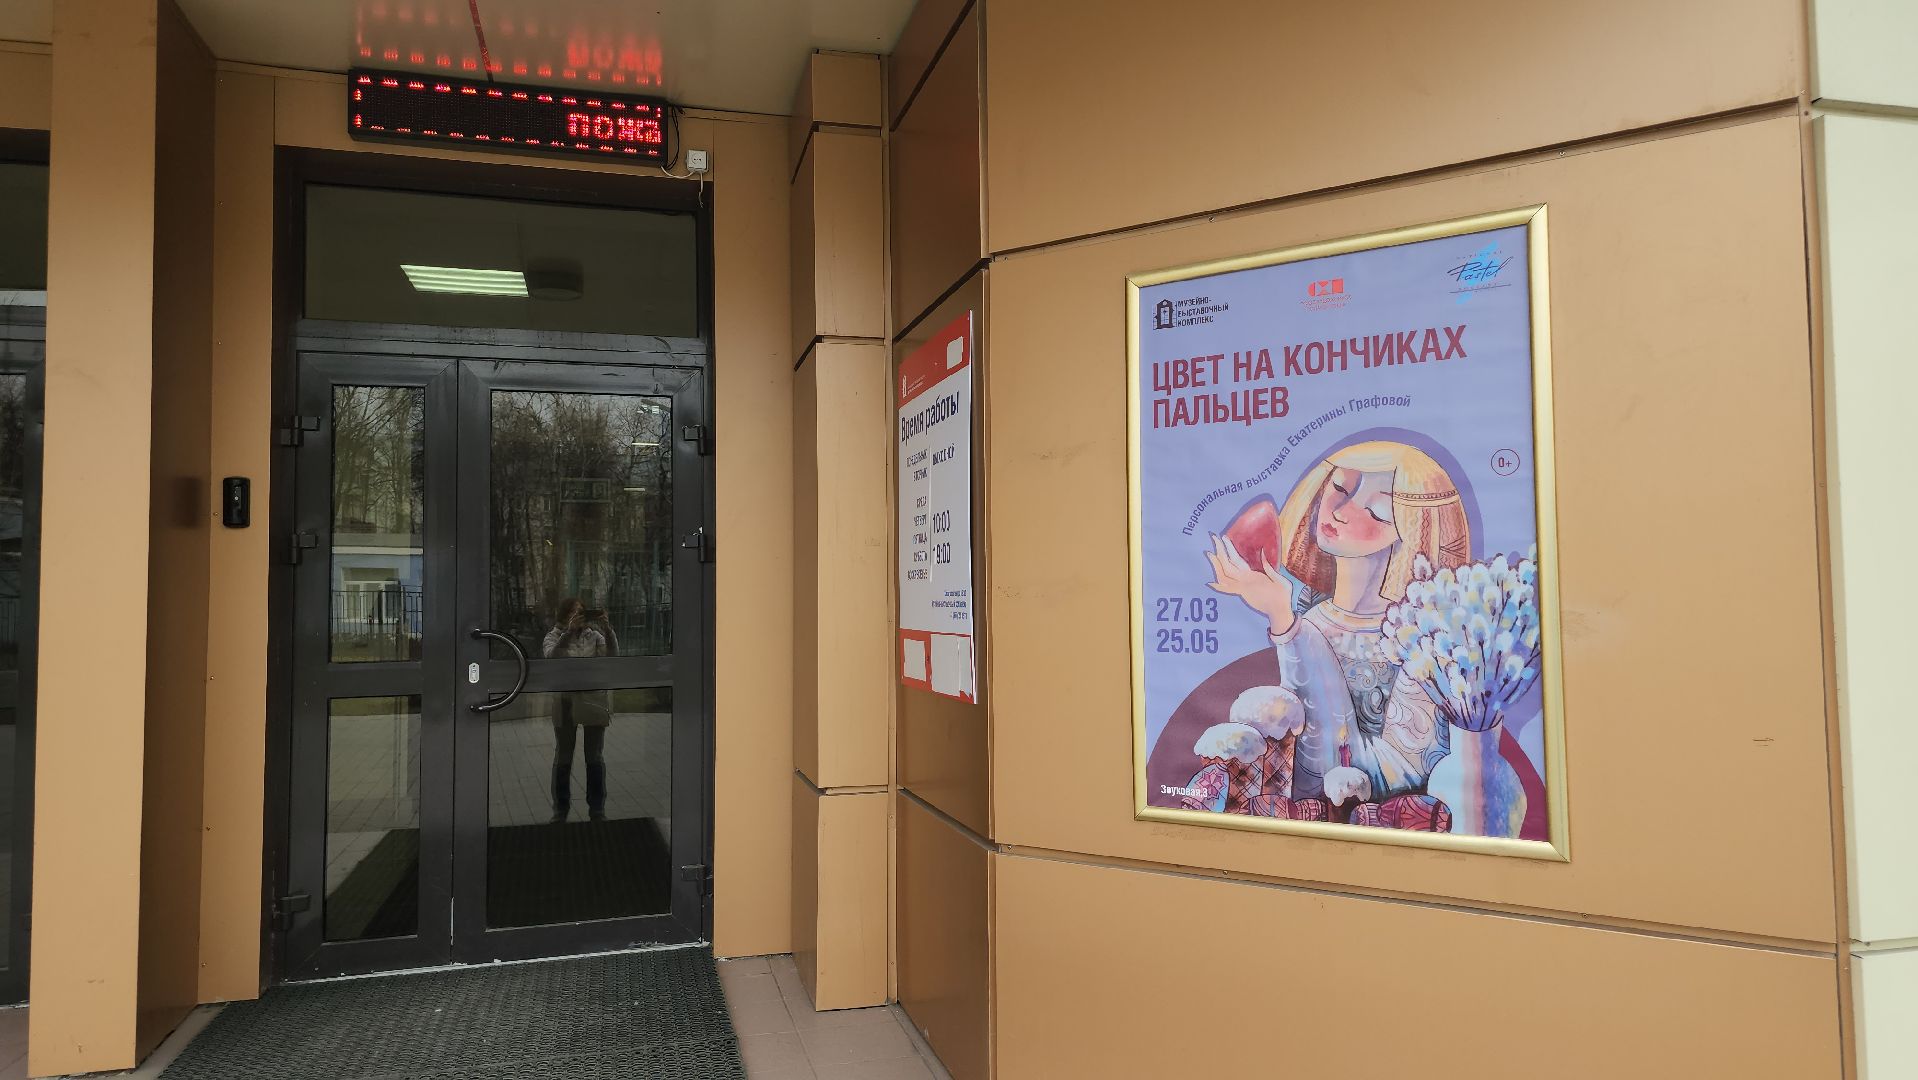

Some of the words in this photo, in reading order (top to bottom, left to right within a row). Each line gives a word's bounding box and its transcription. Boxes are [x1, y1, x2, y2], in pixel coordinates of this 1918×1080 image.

[1177, 296, 1212, 308] МУЗЕЙНО-
[1177, 302, 1229, 318] ВЫСТАВОЧНЫЙ
[1177, 315, 1214, 328] КОМПЛЕКС
[1153, 353, 1225, 396] ЦВЕТ
[1233, 348, 1275, 383] НА
[1283, 324, 1468, 377] КОНЧИКАХ
[901, 410, 924, 447] Время
[925, 390, 960, 436] работы
[1153, 386, 1290, 429] ПАЛЬЦЕВ
[1182, 481, 1243, 536] Персональная
[1246, 446, 1291, 488] выставка
[1287, 405, 1347, 447] Екатерины
[1348, 394, 1411, 412] Графовой
[1498, 456, 1512, 468] 0+
[932, 542, 951, 565] 9:00
[1156, 597, 1219, 623] 27.03
[1156, 628, 1219, 654] 25.05
